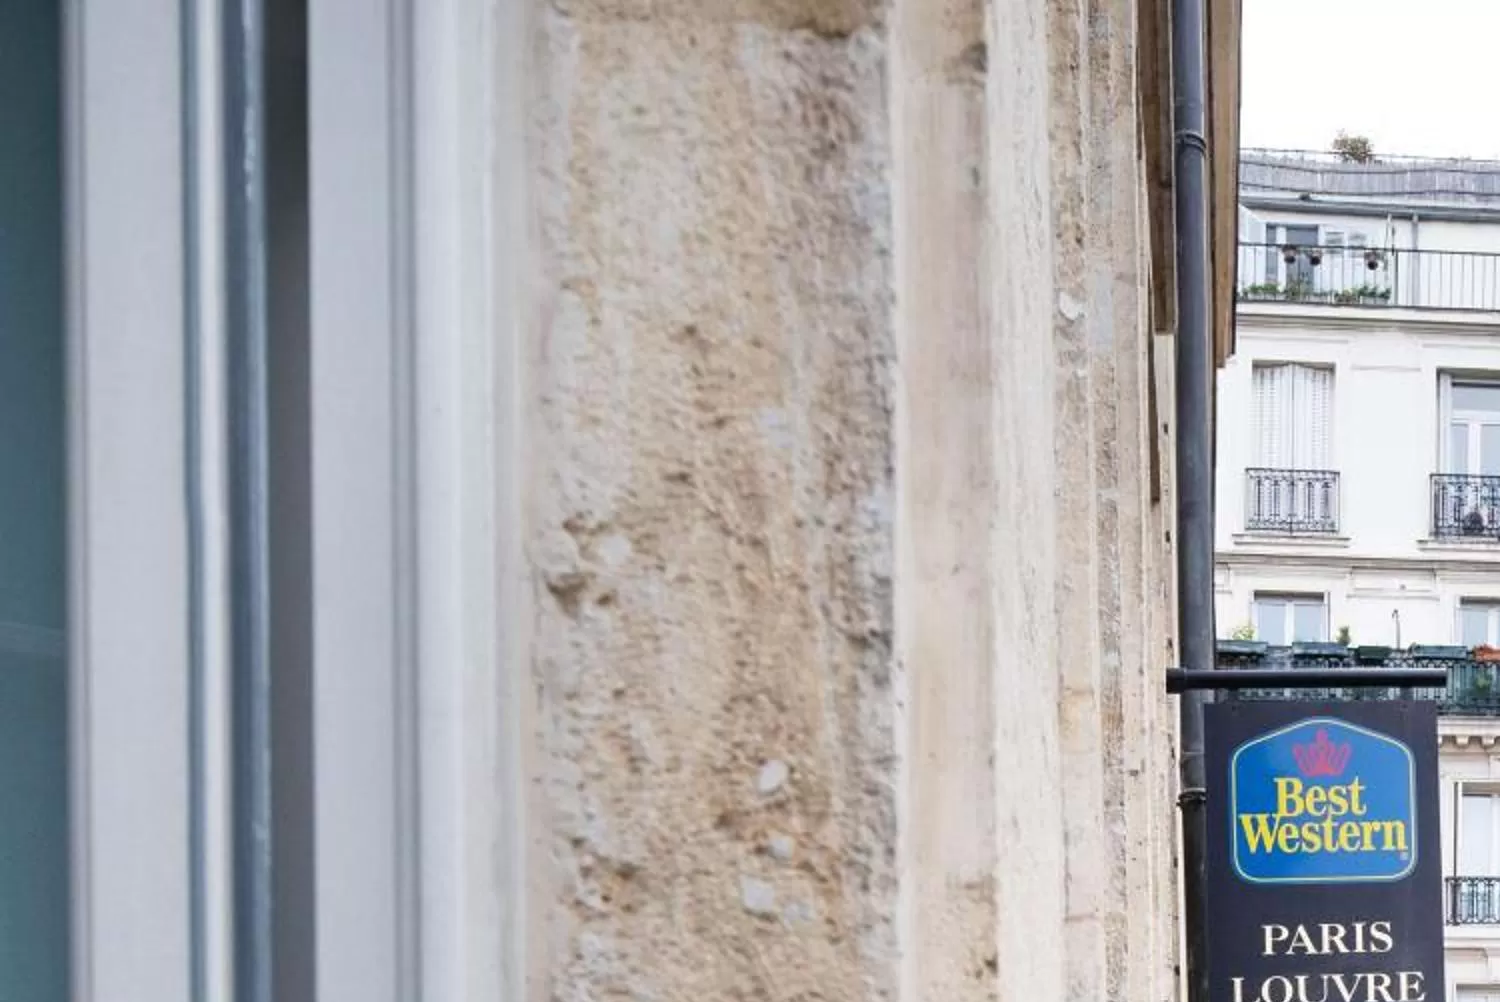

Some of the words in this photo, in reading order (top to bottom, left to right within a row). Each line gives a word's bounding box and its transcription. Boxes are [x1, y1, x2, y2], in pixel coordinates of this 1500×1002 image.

[1273, 776, 1367, 817] Best
[1238, 813, 1409, 854] Western
[1261, 921, 1393, 956] PARIS
